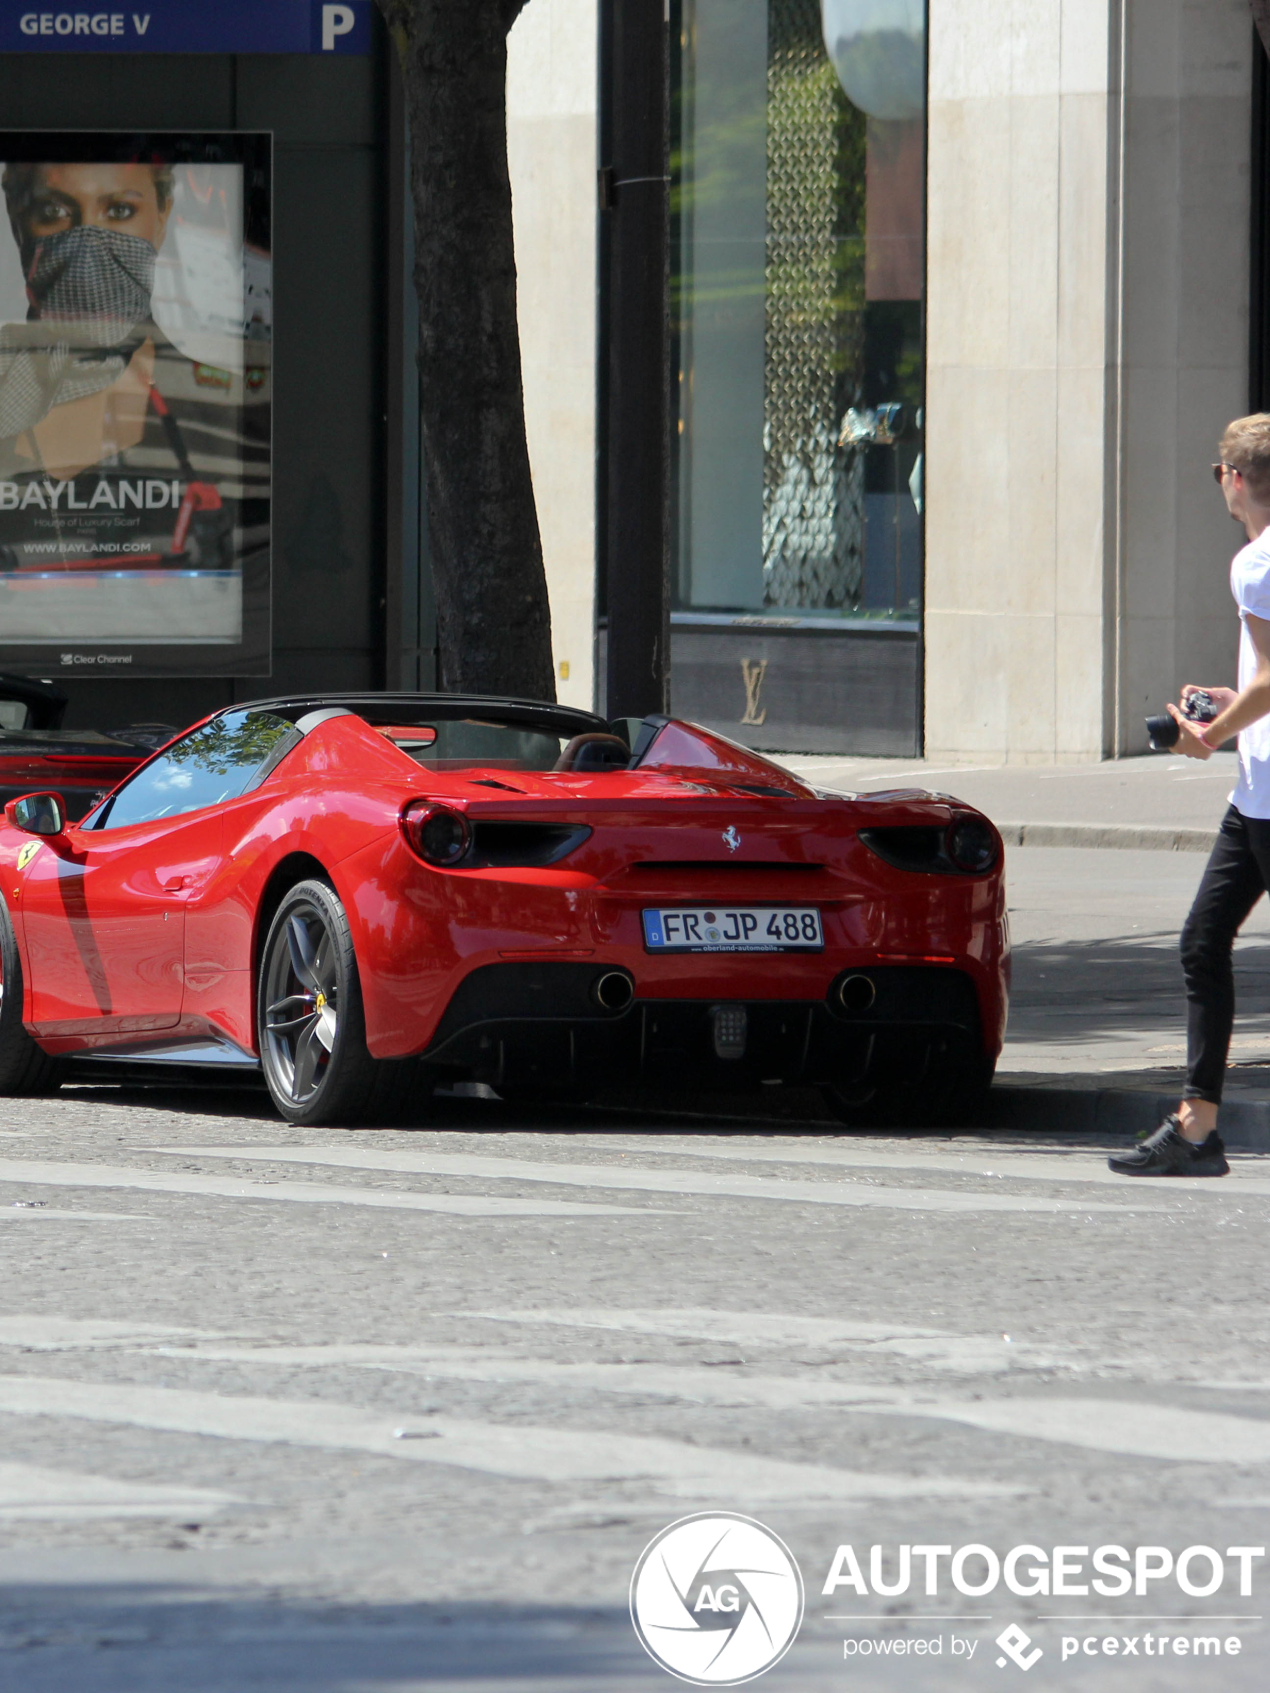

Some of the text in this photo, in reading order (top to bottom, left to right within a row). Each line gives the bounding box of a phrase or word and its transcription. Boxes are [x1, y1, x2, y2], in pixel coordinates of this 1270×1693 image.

[20, 14, 150, 35] GEORGE V
[322, 4, 355, 50] P
[34, 516, 141, 529] House of Luxury Scarf
[23, 542, 152, 554] WWW.BAYLANDI.COM
[73, 653, 133, 664] Clear Channel
[299, 886, 330, 917] POTENZA
[662, 913, 818, 942] FR JP 488
[651, 932, 659, 941] D
